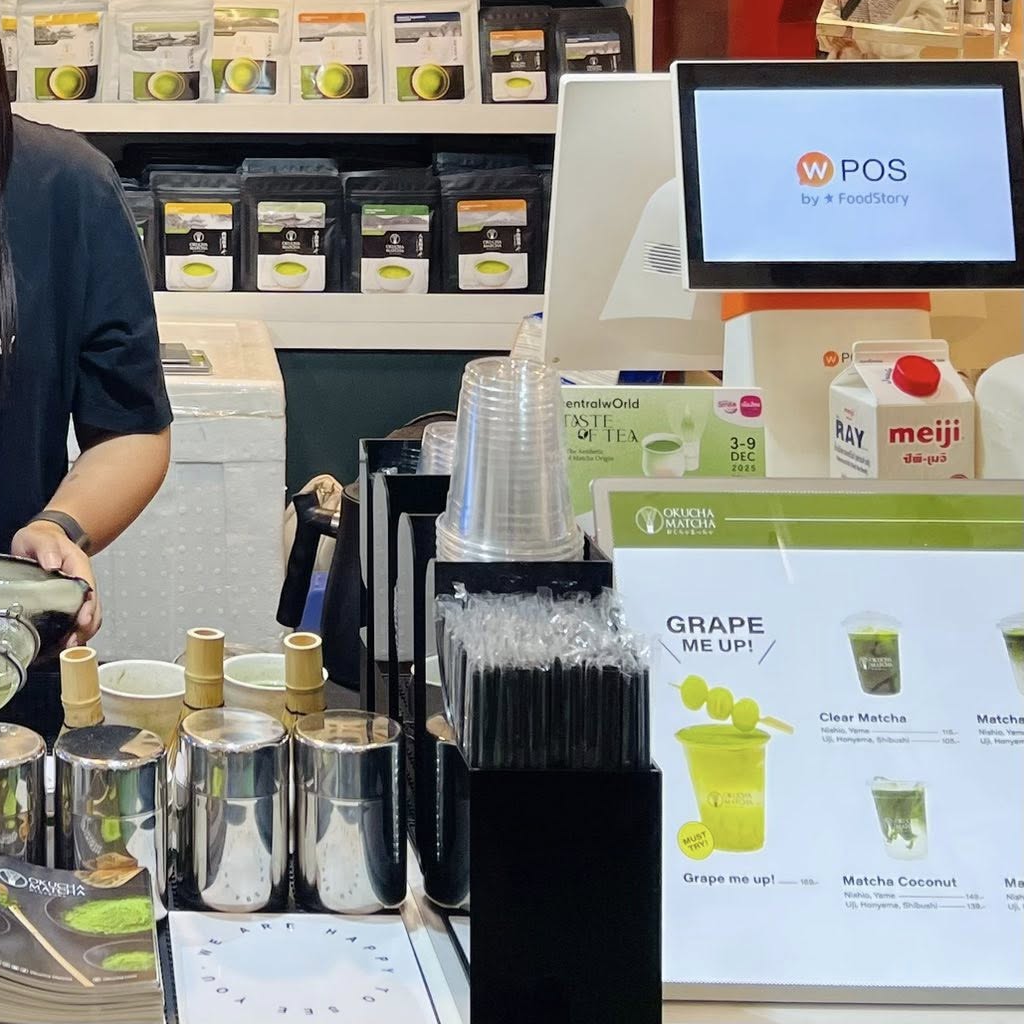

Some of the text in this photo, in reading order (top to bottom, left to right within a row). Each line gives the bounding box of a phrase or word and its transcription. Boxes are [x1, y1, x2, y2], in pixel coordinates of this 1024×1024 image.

[841, 158, 908, 182] POS
[801, 192, 909, 207] by FoodStory
[564, 398, 640, 409] entralwOrld
[564, 414, 613, 428] TASTE
[578, 428, 638, 442] OF TEA
[889, 419, 960, 448] meiji
[730, 437, 756, 450] 3-9
[730, 452, 756, 461] DEC
[732, 464, 756, 472] 2025
[663, 508, 715, 518] OKUCHA
[665, 518, 716, 528] MATCHA
[666, 615, 765, 634] GRAPE
[682, 639, 753, 652] ME UP!
[819, 712, 854, 723] Clear
[858, 713, 907, 723] Matcha
[682, 831, 707, 845] MUST
[687, 839, 709, 852] TRY!
[28, 877, 85, 890] OKUCHA
[683, 873, 775, 887] Grape me up!
[842, 876, 957, 888] Matcha Coconut
